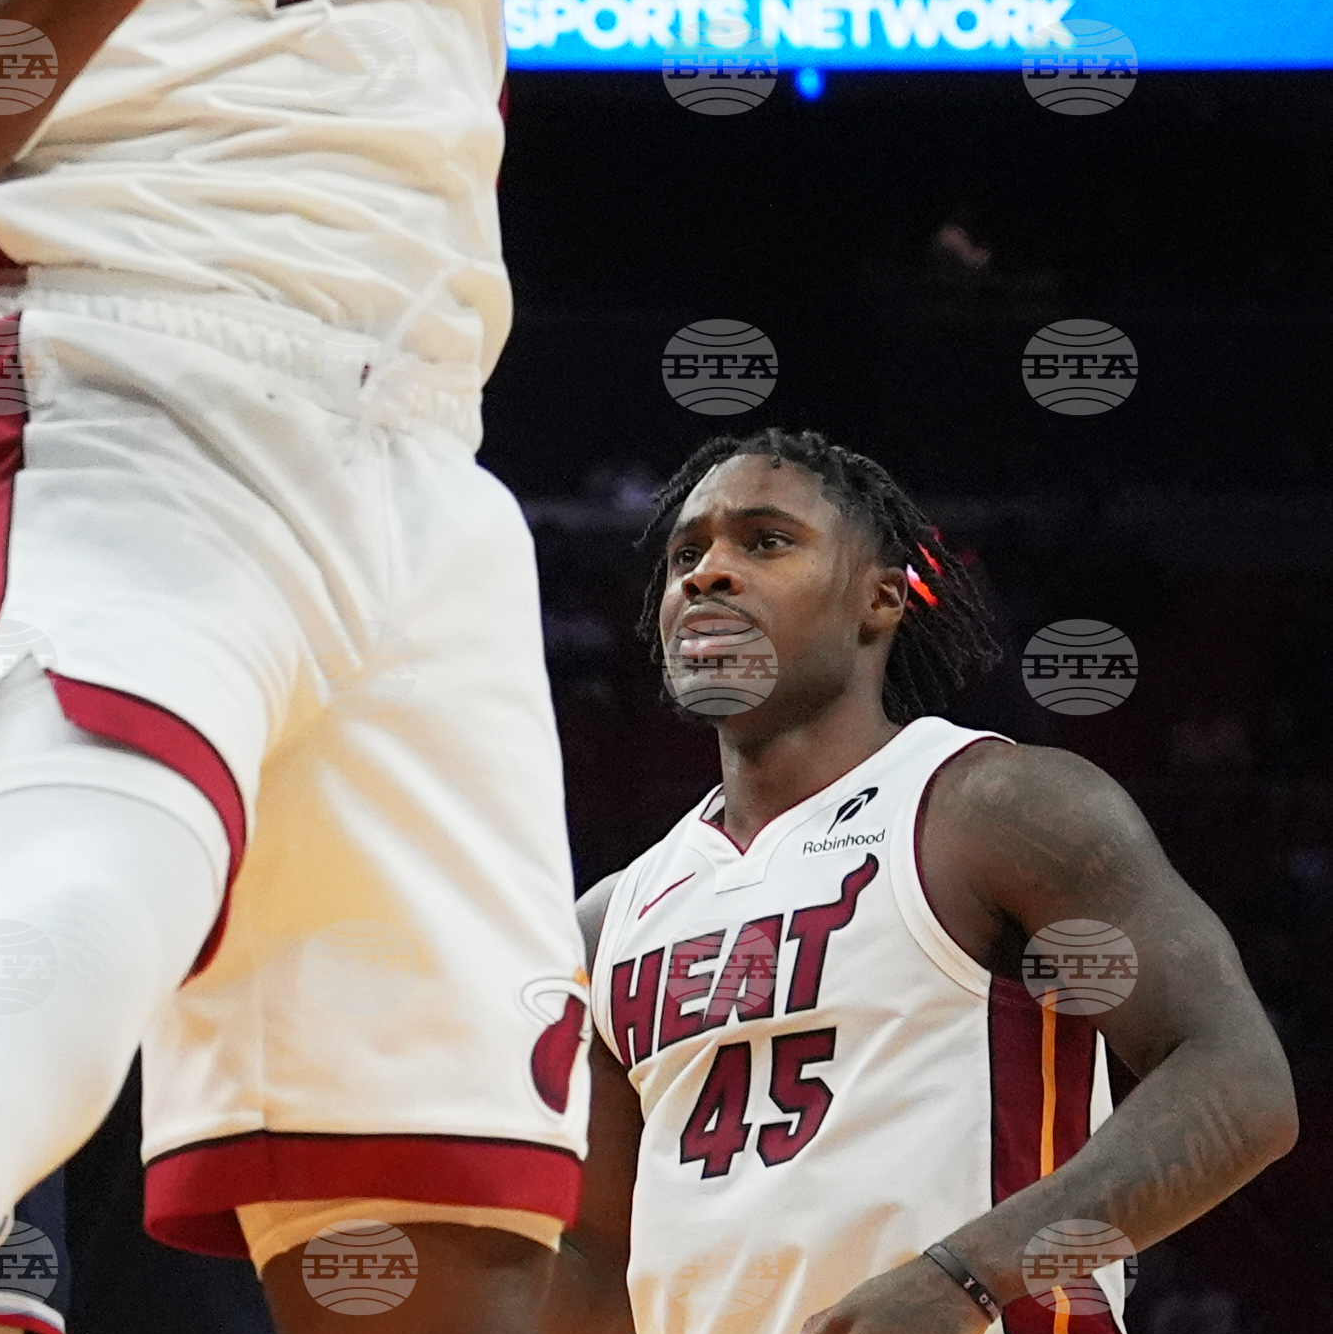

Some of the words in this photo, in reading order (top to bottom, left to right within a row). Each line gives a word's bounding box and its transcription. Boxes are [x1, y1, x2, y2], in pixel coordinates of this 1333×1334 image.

[802, 828, 886, 855] Robinhood
[612, 853, 879, 1066] HEAT
[680, 1026, 837, 1180] 45
